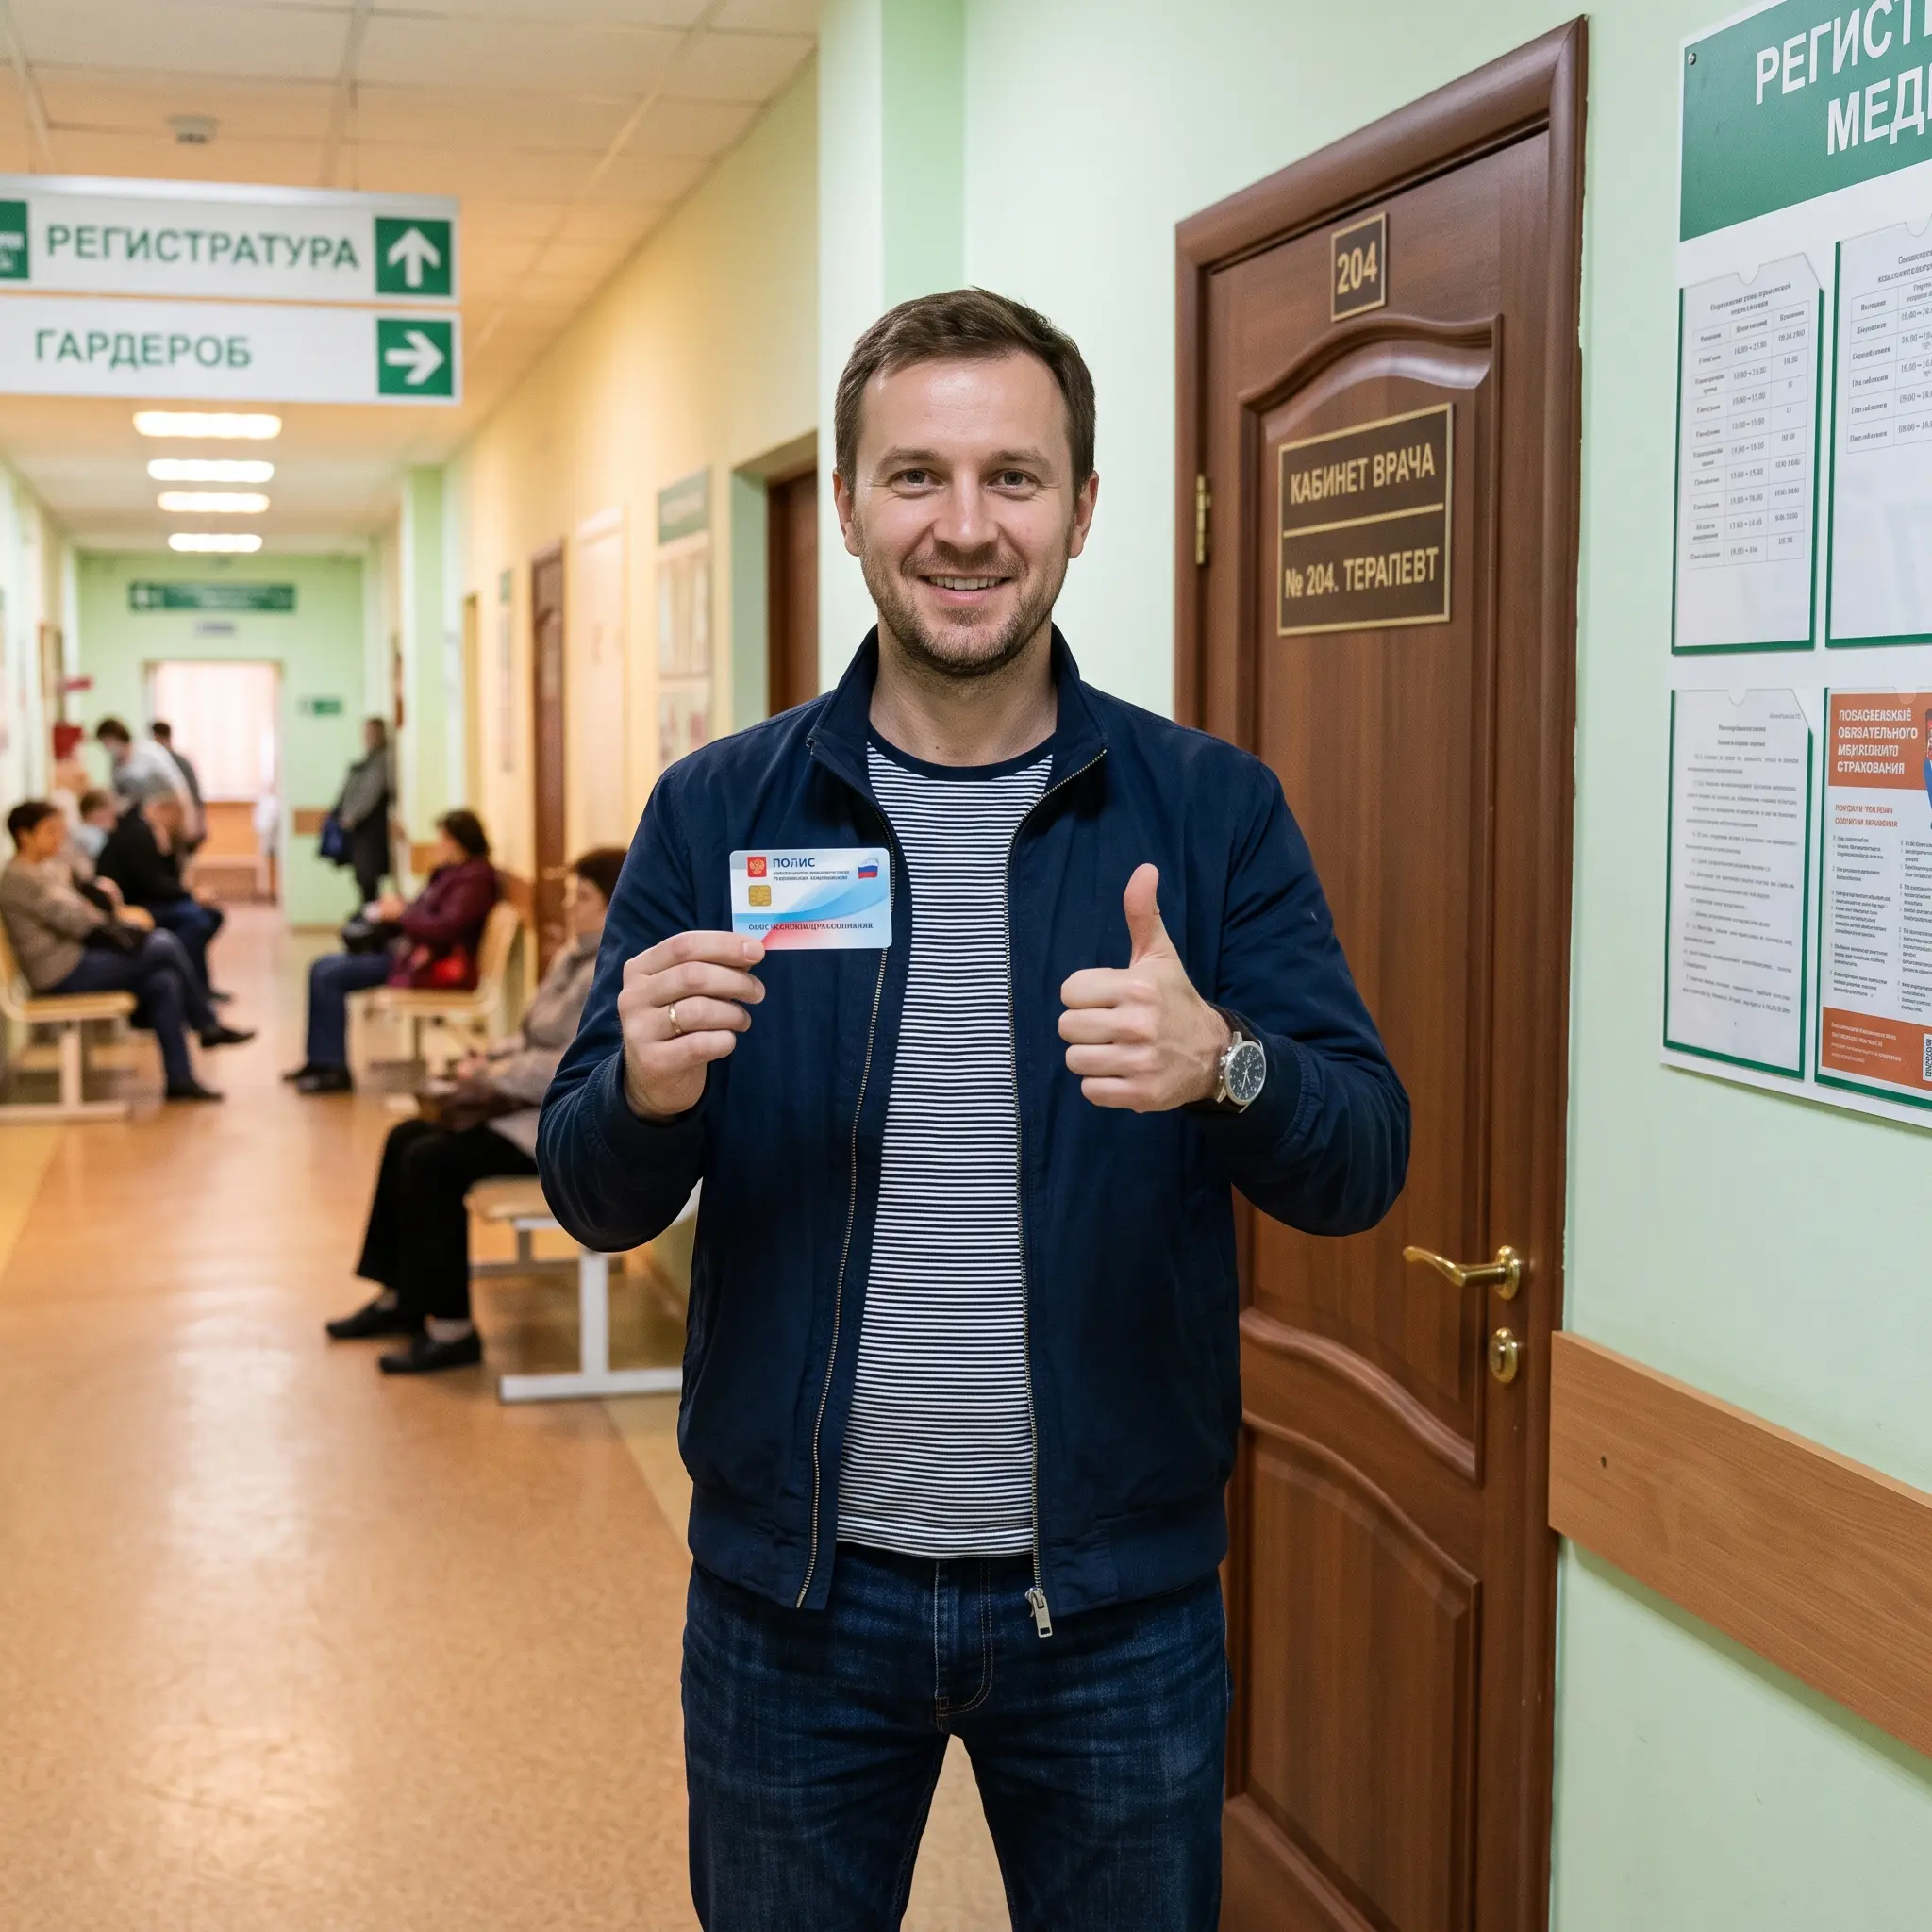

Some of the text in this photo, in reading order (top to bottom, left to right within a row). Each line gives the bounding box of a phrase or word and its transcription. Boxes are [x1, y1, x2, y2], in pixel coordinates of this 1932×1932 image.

[1756, 0, 1932, 106] РЕГИСТ
[1827, 62, 1932, 156] МЕД
[46, 225, 360, 270] РЕГИСТРАТУРА
[1337, 241, 1378, 295] 204
[35, 329, 253, 371] ГАРДЕРОБ
[1291, 442, 1436, 505] КАБИНЕТ ВРАЧА
[1285, 546, 1440, 599] № 204. ТЕРАПЕВТ
[1837, 760, 1905, 774] СТРАХОВАНИЯ
[773, 858, 816, 868] ПОЛИС
